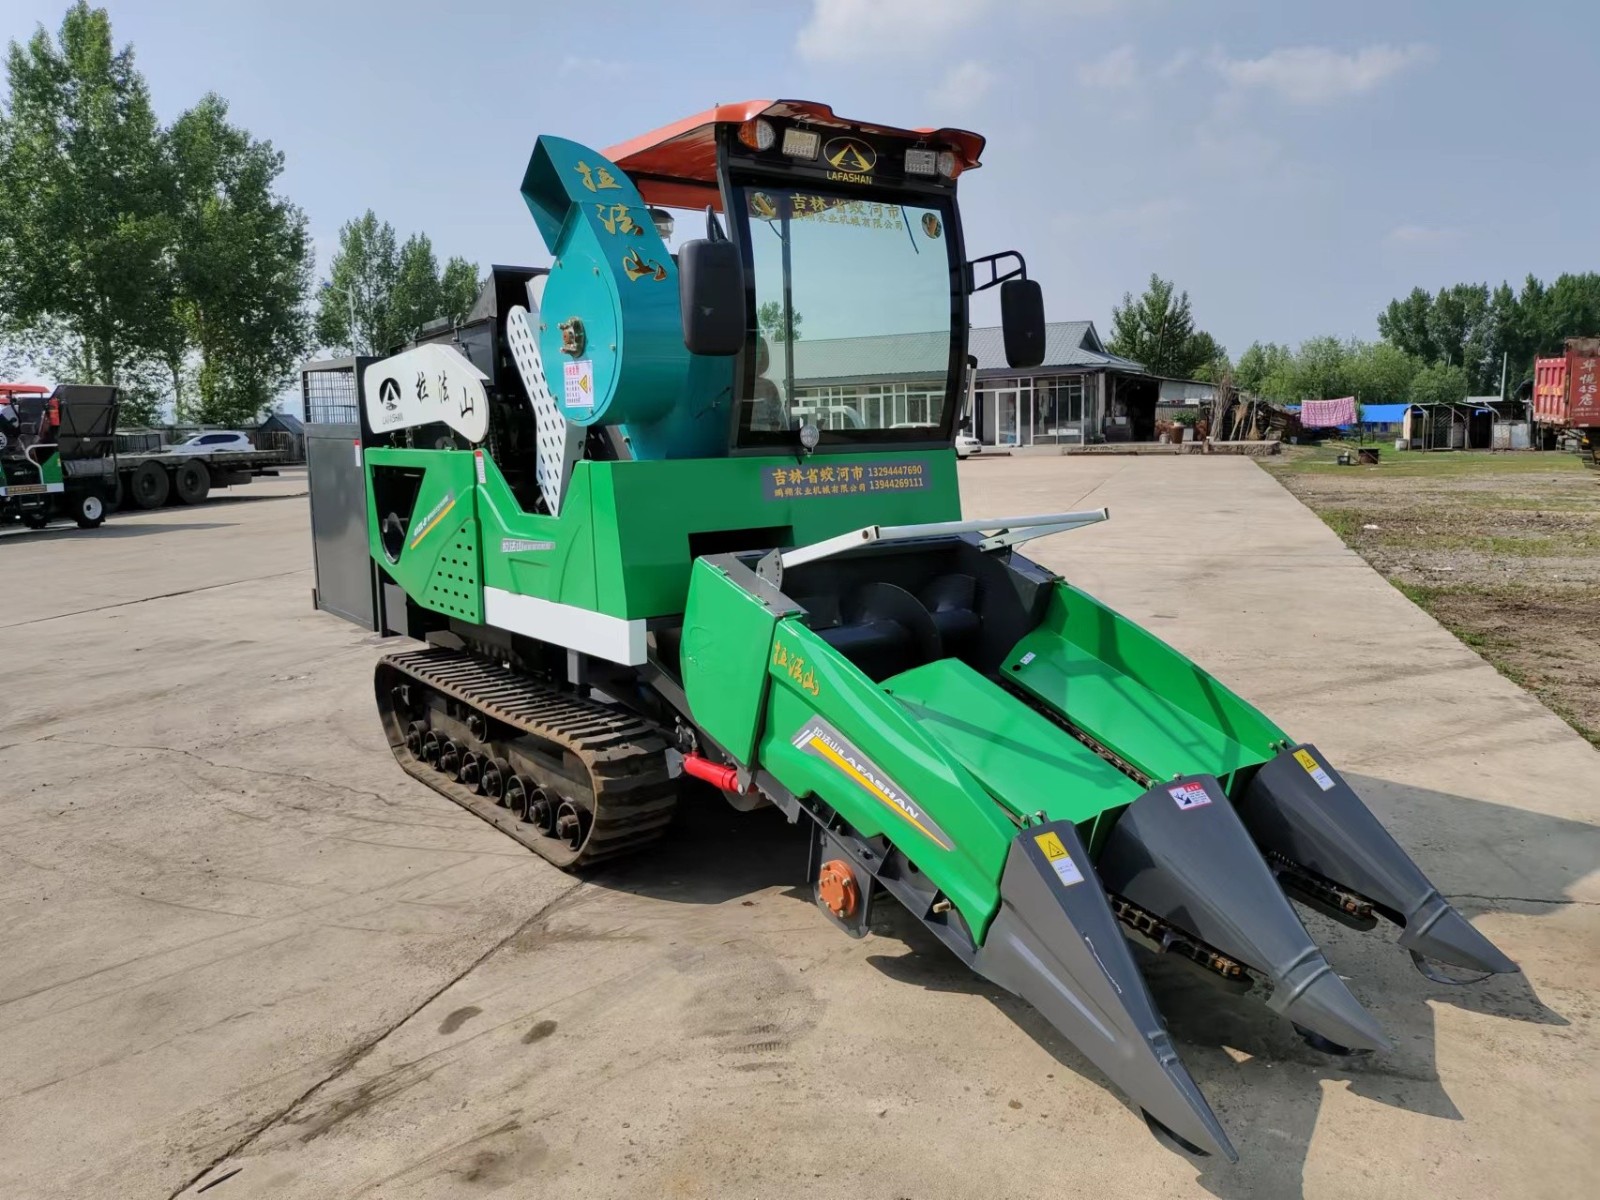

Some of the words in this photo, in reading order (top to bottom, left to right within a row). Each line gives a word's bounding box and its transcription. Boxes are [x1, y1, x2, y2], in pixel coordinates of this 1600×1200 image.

[826, 171, 872, 184] LAFASHAN
[574, 160, 667, 281] 拉法山
[416, 370, 474, 418] 拉法山
[772, 466, 864, 486] 吉林省蛟河市
[869, 478, 924, 490] 13944269111
[773, 639, 820, 697] 拉法山
[813, 727, 840, 752] 拉法山
[838, 748, 919, 819] LAFASHAN
